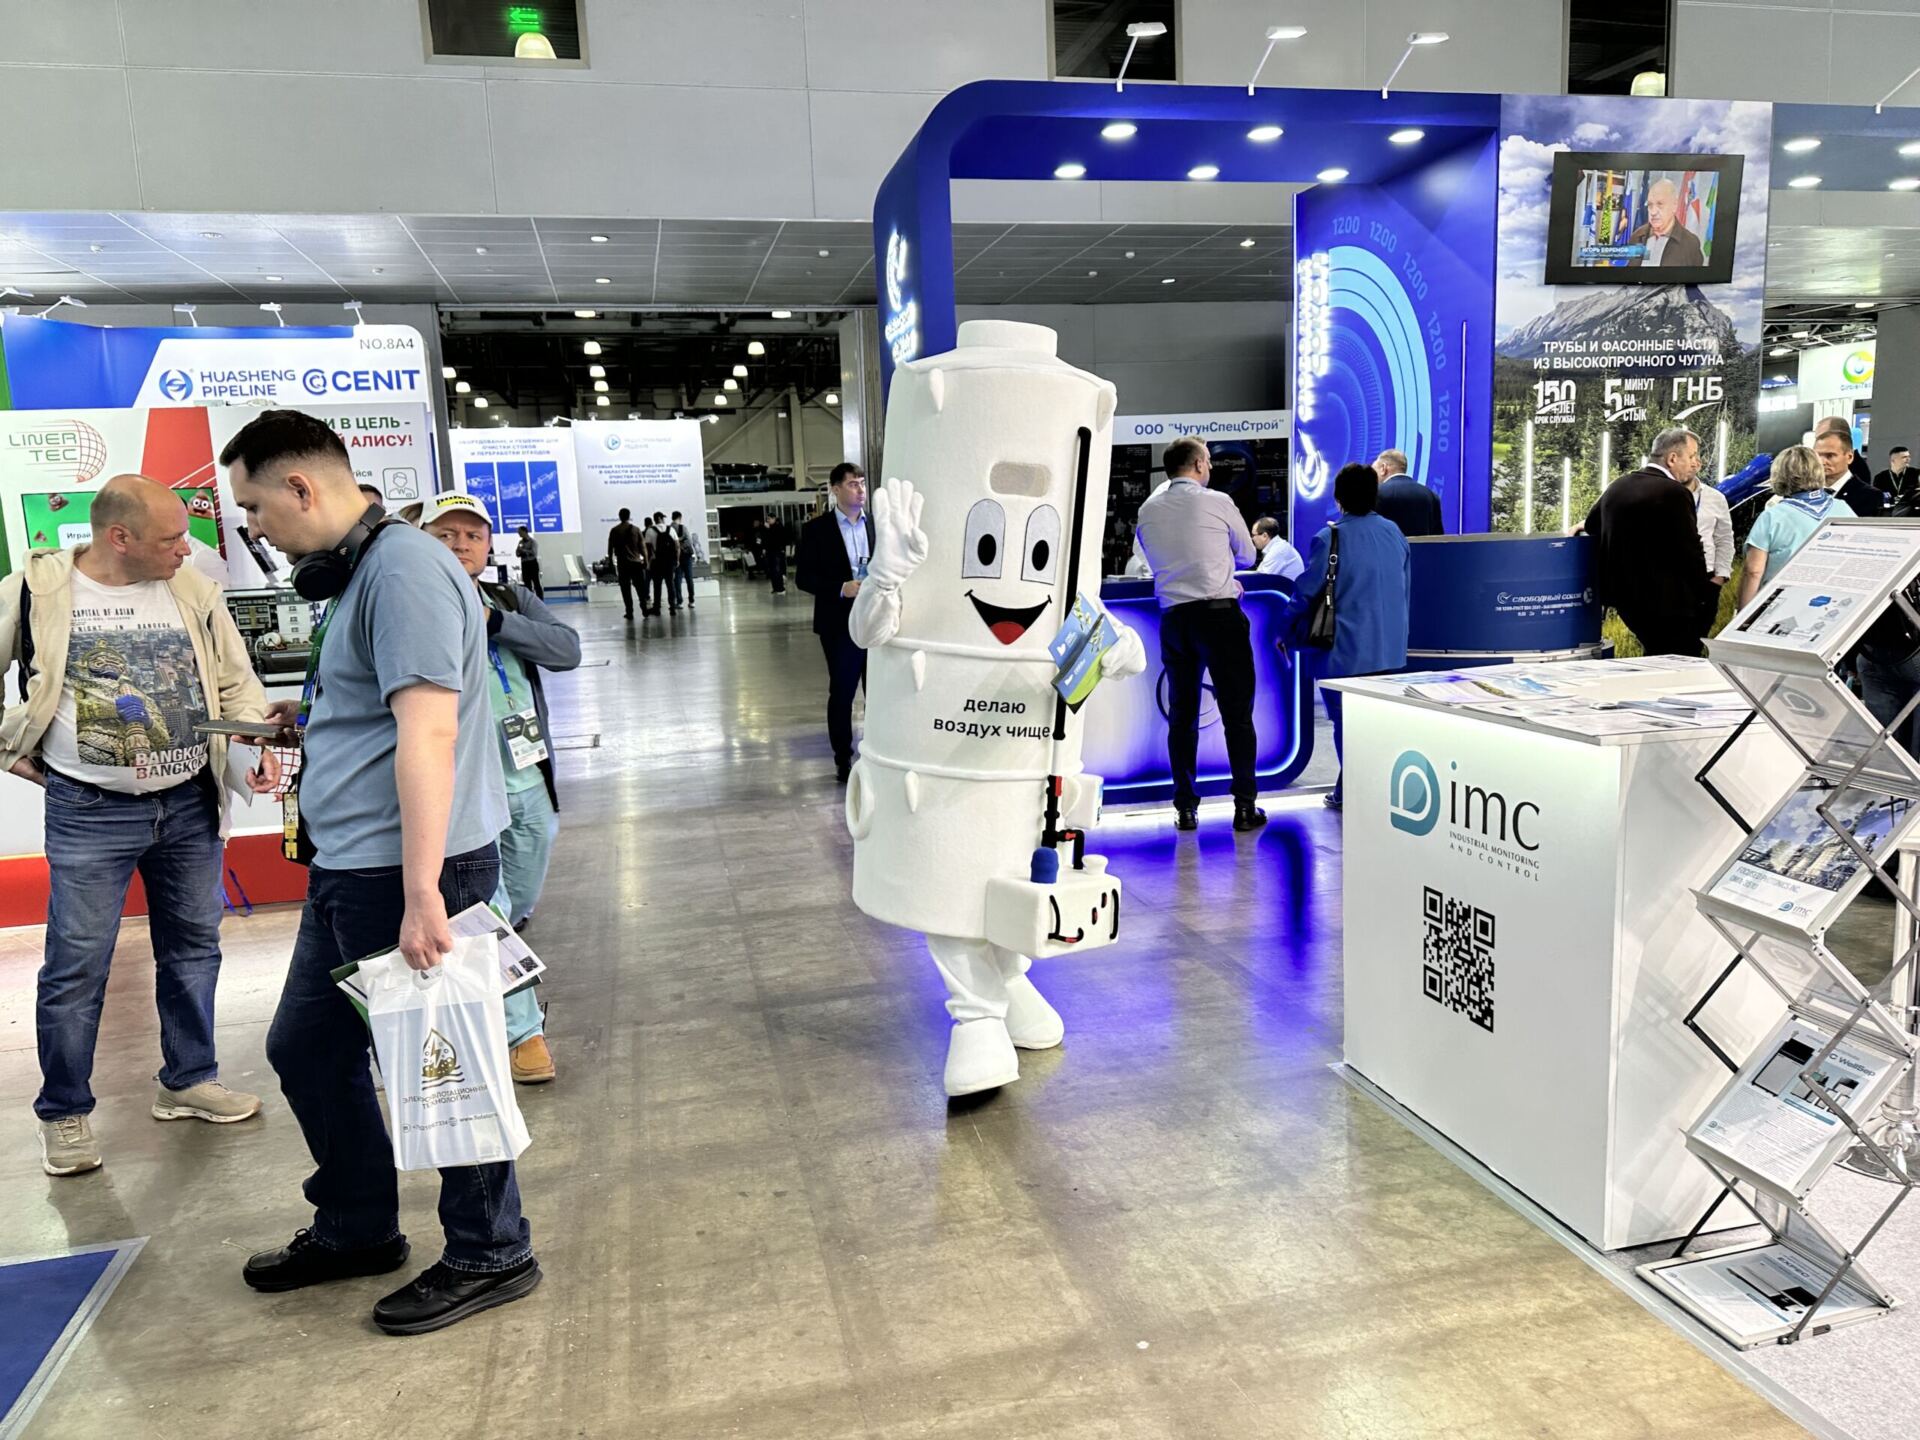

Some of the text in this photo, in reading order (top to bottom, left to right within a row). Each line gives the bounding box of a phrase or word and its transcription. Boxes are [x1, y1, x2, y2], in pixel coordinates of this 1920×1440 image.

[1332, 215, 1360, 236] 1200
[1369, 220, 1397, 253] 1200
[1402, 251, 1429, 301] 1200
[359, 338, 414, 350] NO.8A4
[1427, 311, 1447, 371] 1200
[1543, 338, 1718, 354] ТРУБЫ И ФАСОННЫЕ ЧАСТИ
[1533, 354, 1724, 369] ИЗ ВЫСОКОПРОЧНОГО ЧУГУНА
[200, 369, 296, 382] HUASHENG
[332, 369, 420, 392] CENIT
[202, 384, 277, 397] PIPELINE
[1533, 379, 1576, 407] 150
[1604, 377, 1655, 418] 5 МИНУТ
[1672, 377, 1724, 401] ГНБ
[1623, 394, 1636, 406] НА
[1438, 390, 1451, 452] 1200
[1549, 414, 1576, 424] СЛУЖБЫ
[1624, 408, 1647, 421] СТЫК
[341, 417, 351, 429] В
[356, 416, 400, 431] ЦЕЛЬ
[1135, 418, 1285, 436] ООО "ЧугунСпецСтрой"
[9, 432, 78, 447] LINER
[351, 434, 413, 448] АЛИСУ!
[29, 448, 78, 462] TEC
[1512, 593, 1561, 603] СВОБОДНЫЙ
[72, 607, 135, 618] CAPITAL OF ASIAN
[963, 699, 1026, 714] делаю
[933, 717, 1050, 738] воздух чище
[1450, 760, 1540, 851] imc
[1449, 831, 1540, 869] INDUSTRIAL MONITORING
[1450, 842, 1540, 881] AND CONTROL
[1839, 1057, 1876, 1077] WellSep
